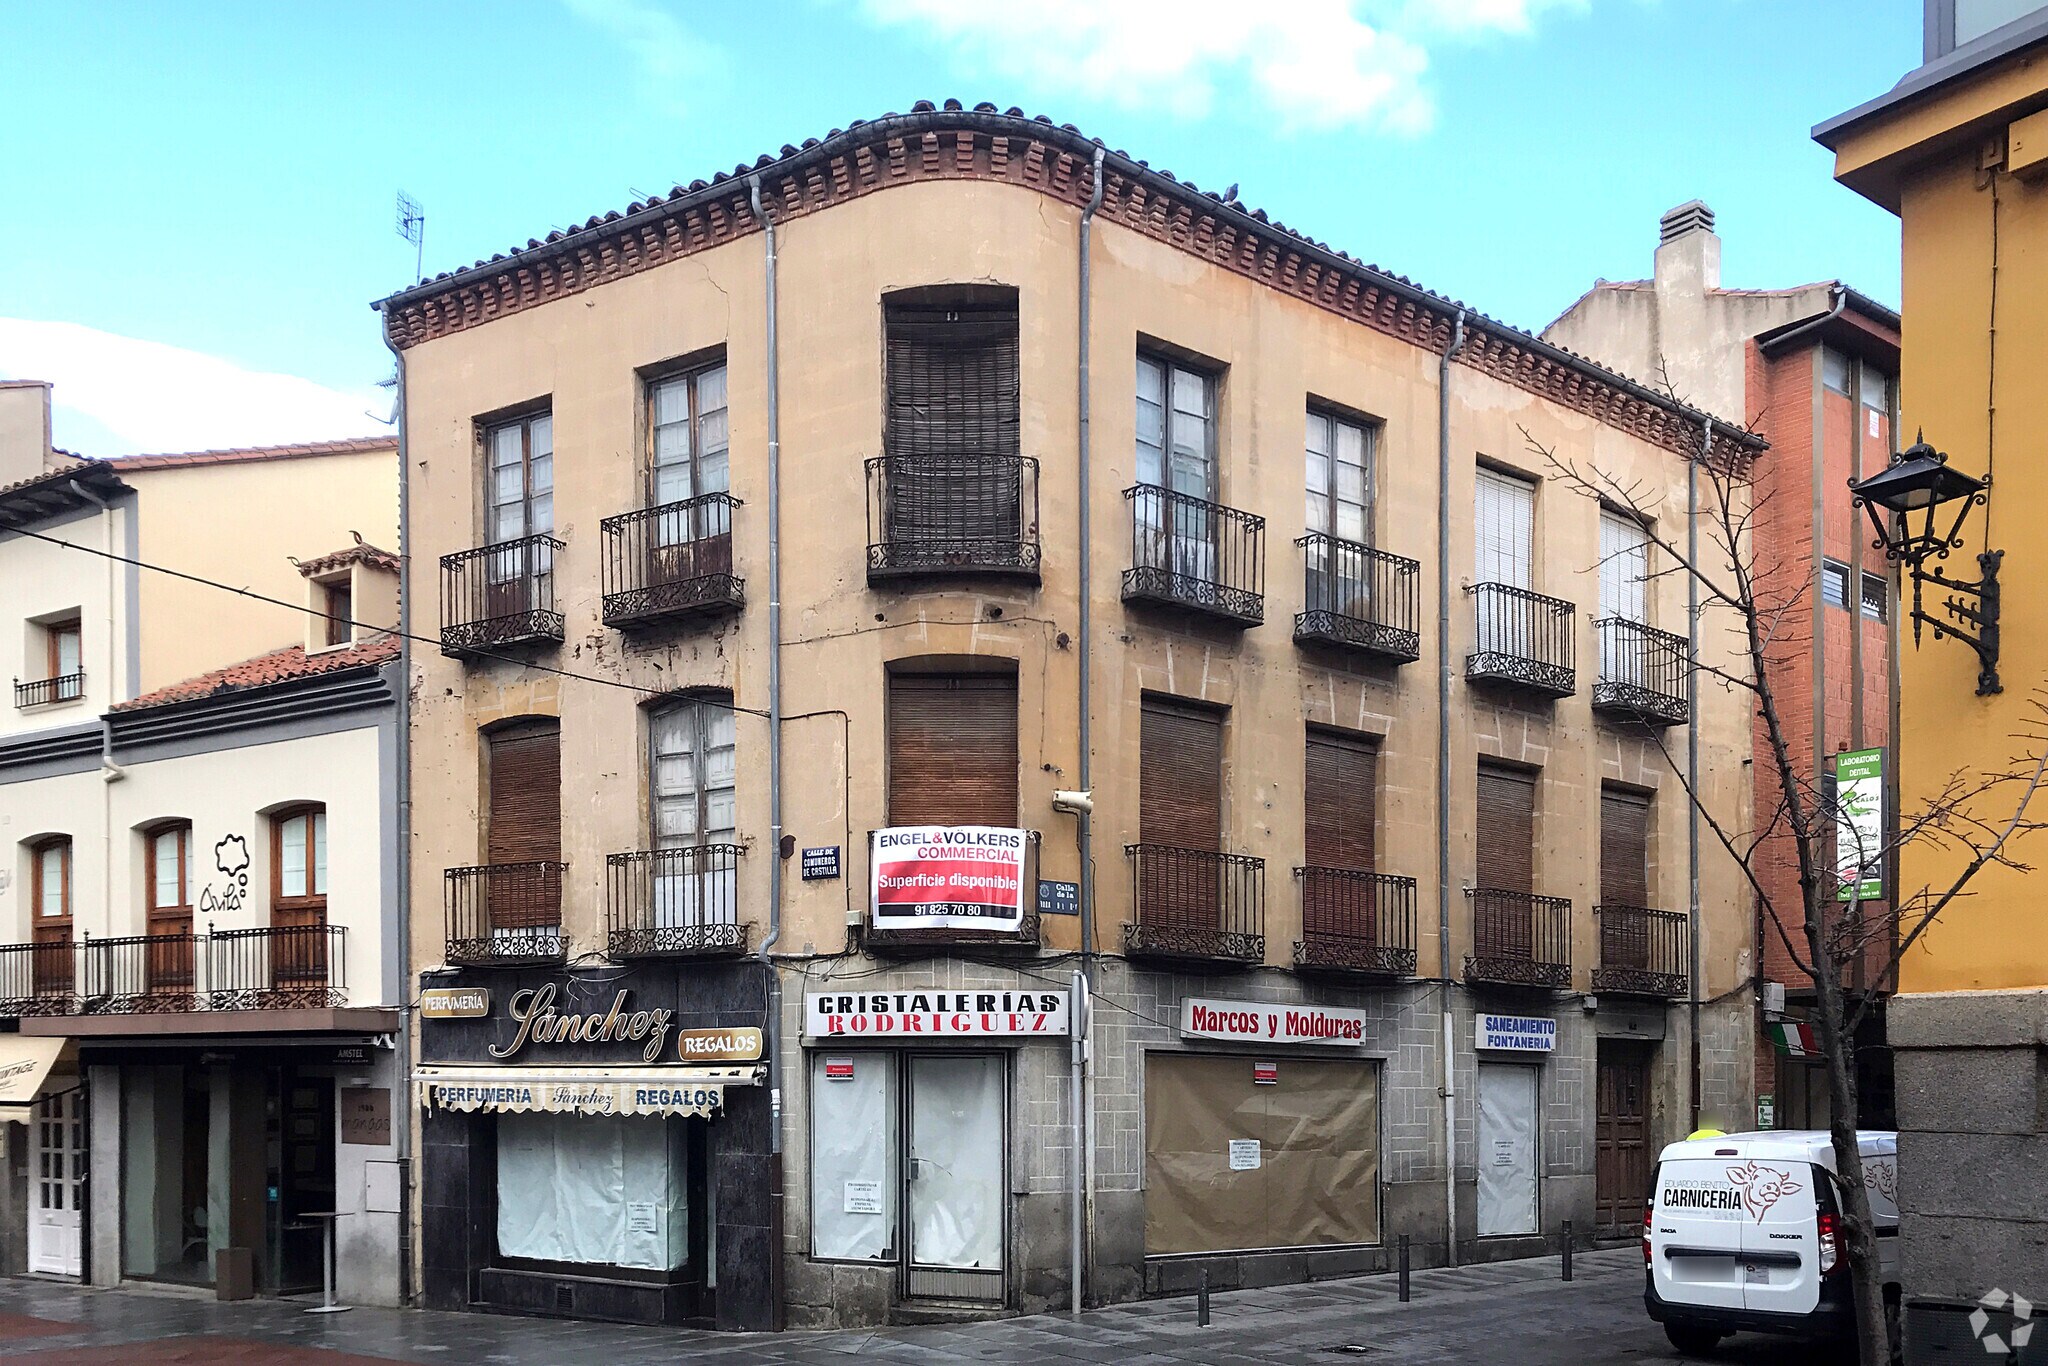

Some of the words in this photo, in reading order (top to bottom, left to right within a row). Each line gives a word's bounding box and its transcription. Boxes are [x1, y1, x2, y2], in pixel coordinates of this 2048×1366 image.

[1840, 754, 1880, 767] LABORATORIO
[1849, 767, 1871, 777] DENTAL
[880, 829, 1020, 848] ENGEL&VÖLKERS
[806, 849, 824, 857] CALLE
[825, 848, 834, 856] DE
[917, 847, 1019, 862] COMMERCIAL
[803, 856, 836, 868] COMUNEROS
[803, 867, 811, 877] DE
[811, 865, 838, 877] CASTILLA
[879, 873, 946, 890] Superficie
[949, 872, 1018, 890] disponible
[1055, 883, 1075, 892] Calle
[1056, 890, 1065, 898] de
[1066, 891, 1074, 899] la
[914, 905, 926, 915] 91
[929, 904, 949, 915] 825
[951, 904, 965, 915] 70
[967, 905, 981, 916] 80
[818, 992, 1060, 1014] CRISTALERÍAS
[488, 982, 672, 1063] Sánchez
[827, 1013, 1048, 1033] RODRIGUEZ
[1192, 1005, 1259, 1034] Marcos
[1268, 1014, 1278, 1039] y
[1285, 1011, 1362, 1039] Molduras
[1485, 1017, 1555, 1035] SANEAMIENTO
[684, 1035, 757, 1054] REGALOS
[1487, 1034, 1551, 1050] FONTANERIA
[337, 1048, 363, 1058] AMSTEL
[439, 1087, 532, 1103] PERFUMERIA
[553, 1086, 614, 1111] Sánchez
[636, 1089, 719, 1106] REGALOS
[1664, 1179, 1699, 1188] EDUARDO
[1700, 1180, 1730, 1190] BENITO
[1663, 1187, 1742, 1210] CARNICERÍA
